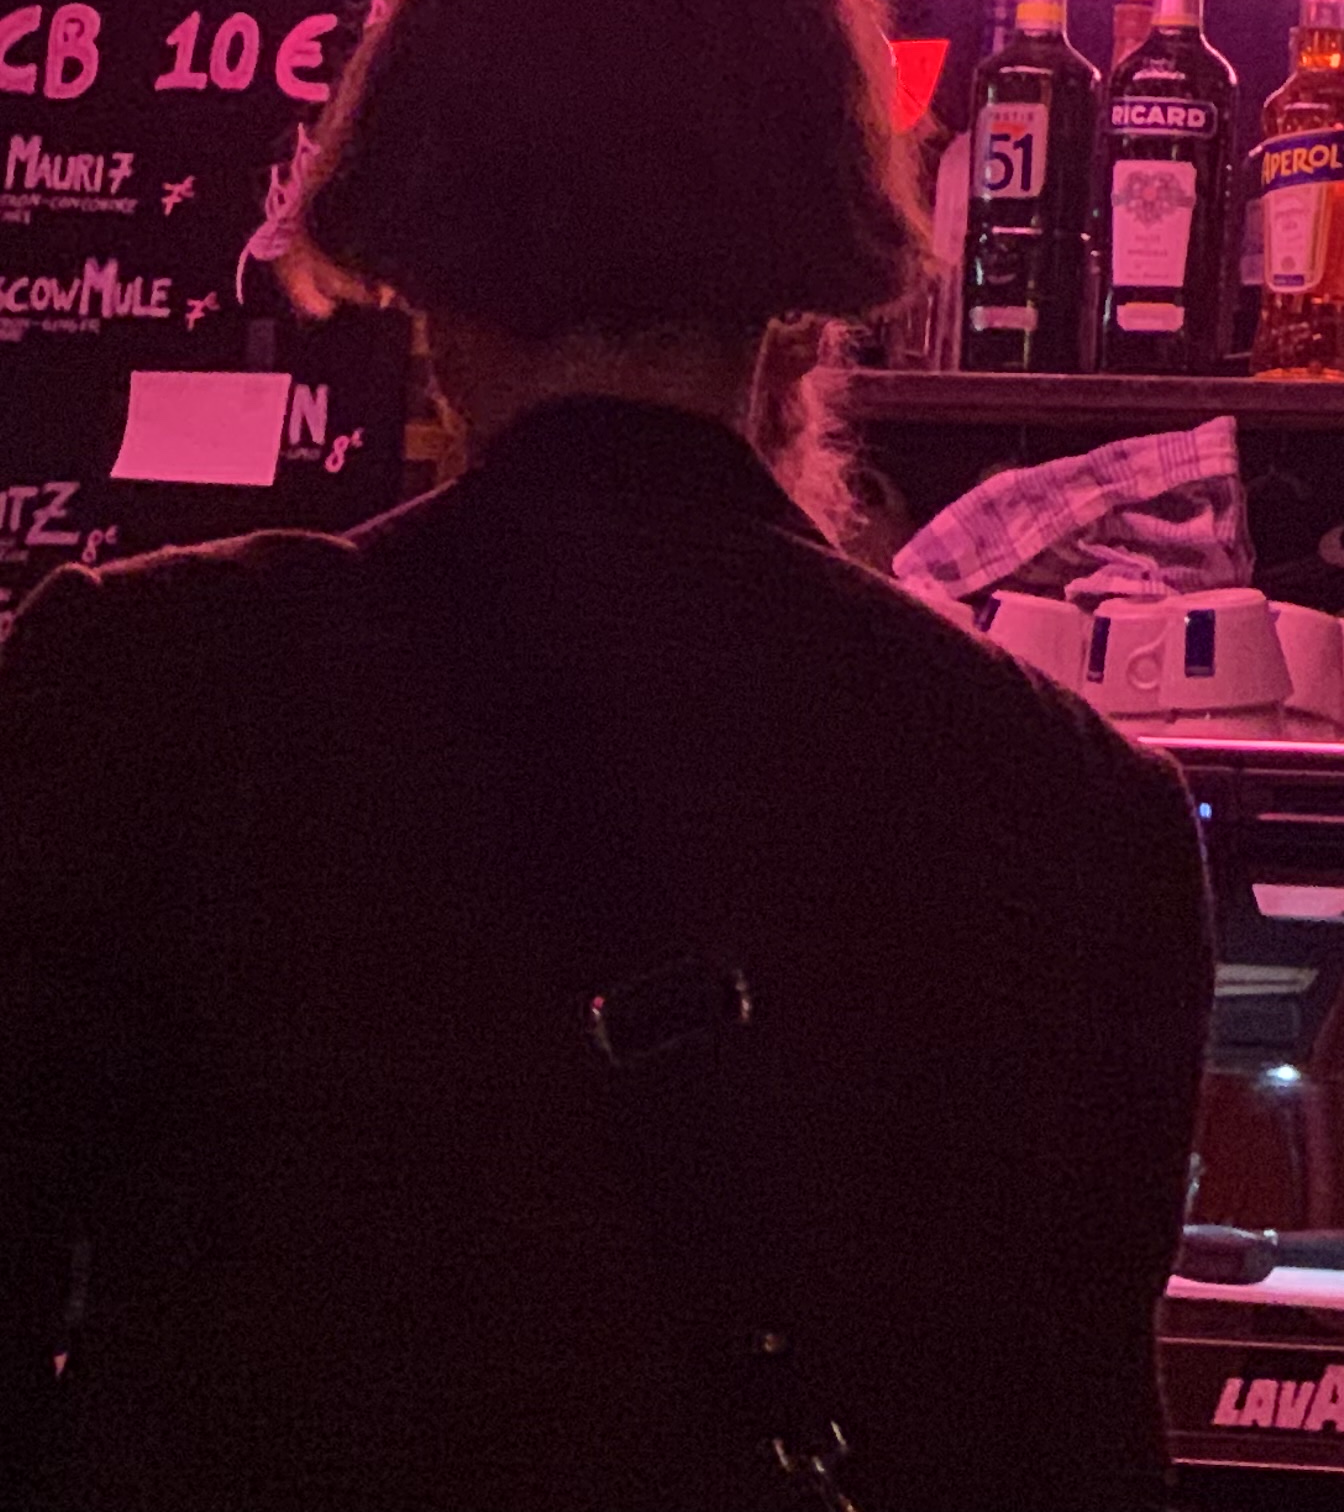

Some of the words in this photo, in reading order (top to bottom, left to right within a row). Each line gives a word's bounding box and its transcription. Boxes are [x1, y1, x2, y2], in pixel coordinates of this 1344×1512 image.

[0, 2, 101, 99] CB
[1111, 104, 1206, 128] RICARD
[986, 134, 1033, 191] 51
[1261, 143, 1344, 185] APEROL
